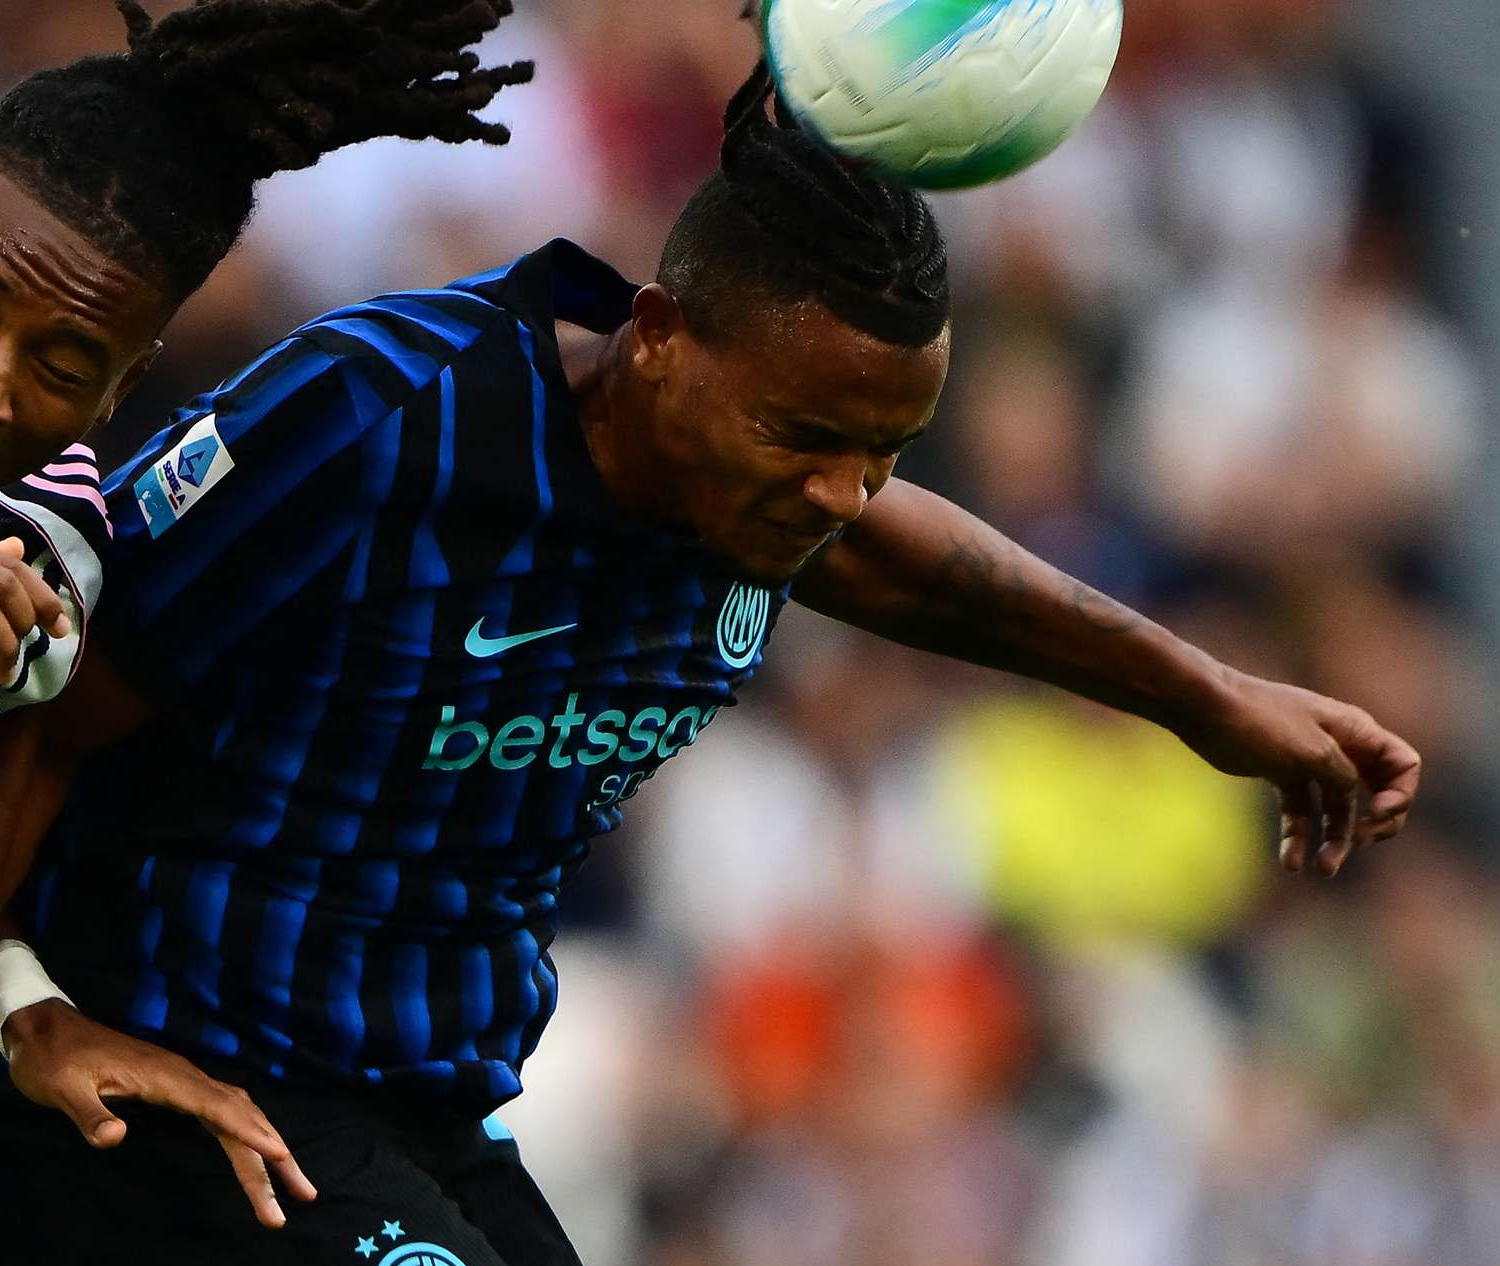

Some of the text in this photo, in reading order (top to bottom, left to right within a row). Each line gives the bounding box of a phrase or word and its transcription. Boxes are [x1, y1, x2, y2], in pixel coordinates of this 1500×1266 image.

[162, 460, 186, 506] SERIE A
[421, 692, 722, 771] betsso
